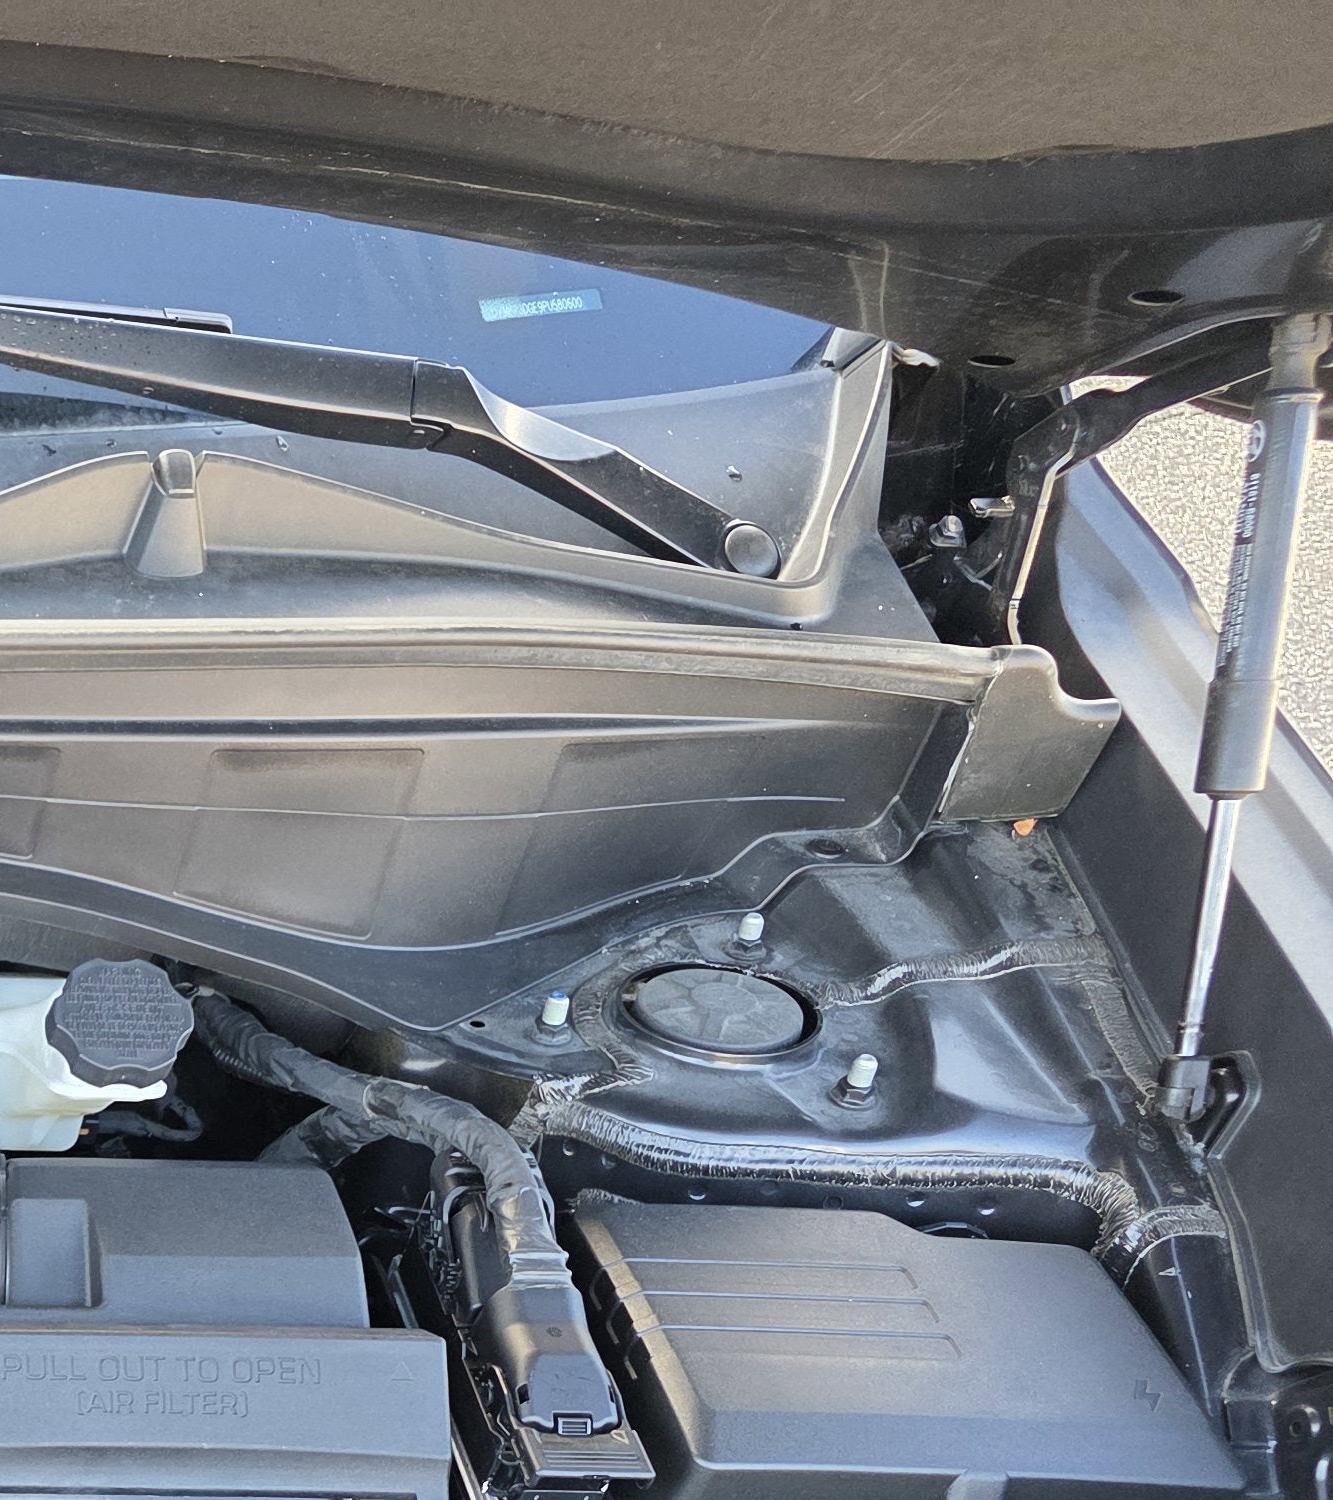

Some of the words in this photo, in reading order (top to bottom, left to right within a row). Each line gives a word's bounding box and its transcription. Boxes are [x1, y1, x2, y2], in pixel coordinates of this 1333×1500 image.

[1, 1354, 87, 1381] PULL
[98, 1355, 166, 1382] OUT
[176, 1356, 220, 1383] TO
[232, 1357, 321, 1385] OPEN
